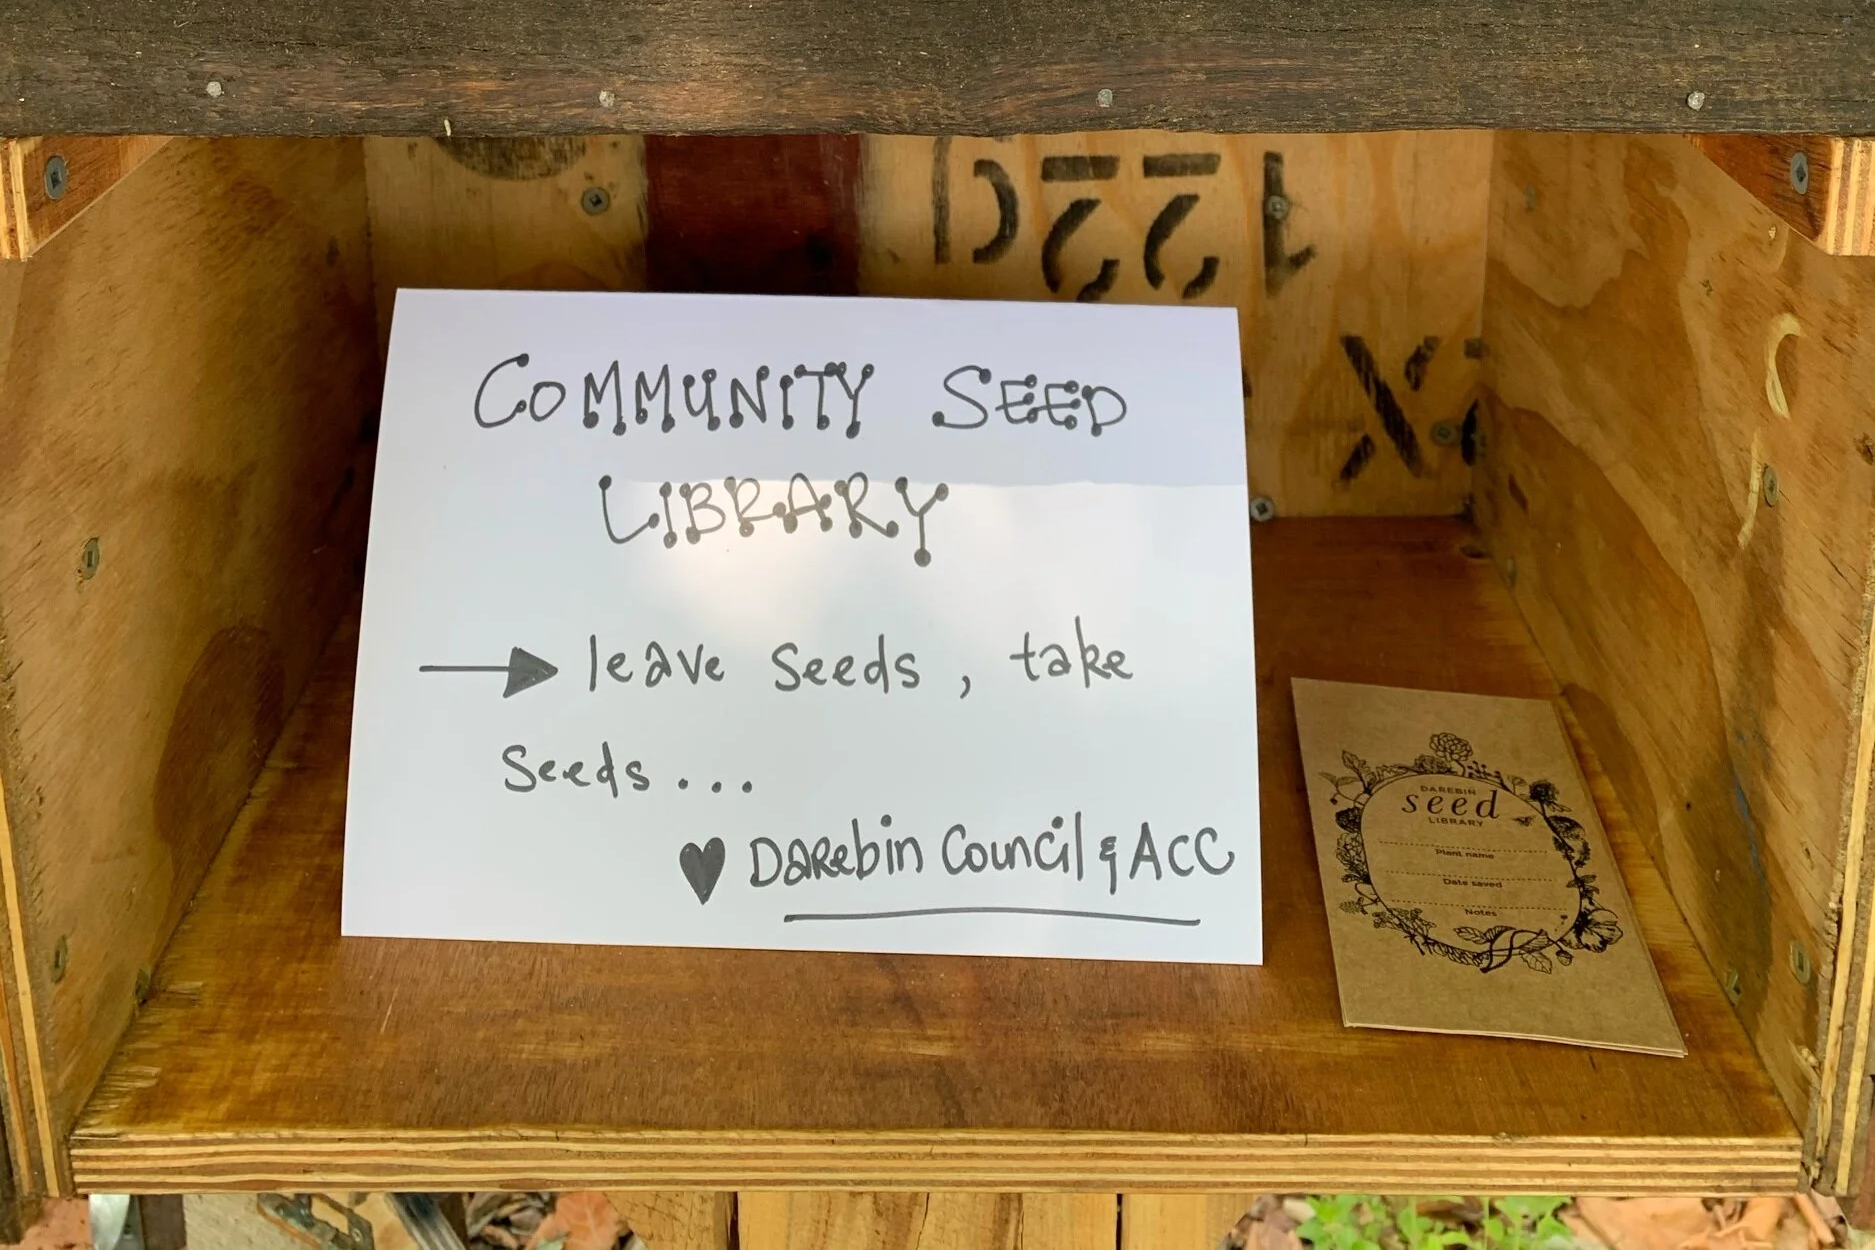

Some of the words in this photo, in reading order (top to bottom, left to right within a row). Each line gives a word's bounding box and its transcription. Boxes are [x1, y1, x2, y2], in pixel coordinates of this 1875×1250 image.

[931, 364, 1127, 438] SEED
[598, 471, 950, 568] LIBRARY
[589, 633, 726, 692] leave
[1009, 615, 1133, 689] take
[1419, 785, 1477, 796] DAREBIN
[1401, 789, 1500, 819] seed
[1428, 816, 1484, 828] LIBRARY
[1129, 821, 1236, 882] ACC
[1435, 848, 1463, 858] Plant
[1465, 852, 1495, 860] name
[1442, 878, 1469, 886] Date
[1471, 880, 1503, 889] saved
[1464, 908, 1498, 917] Notes
